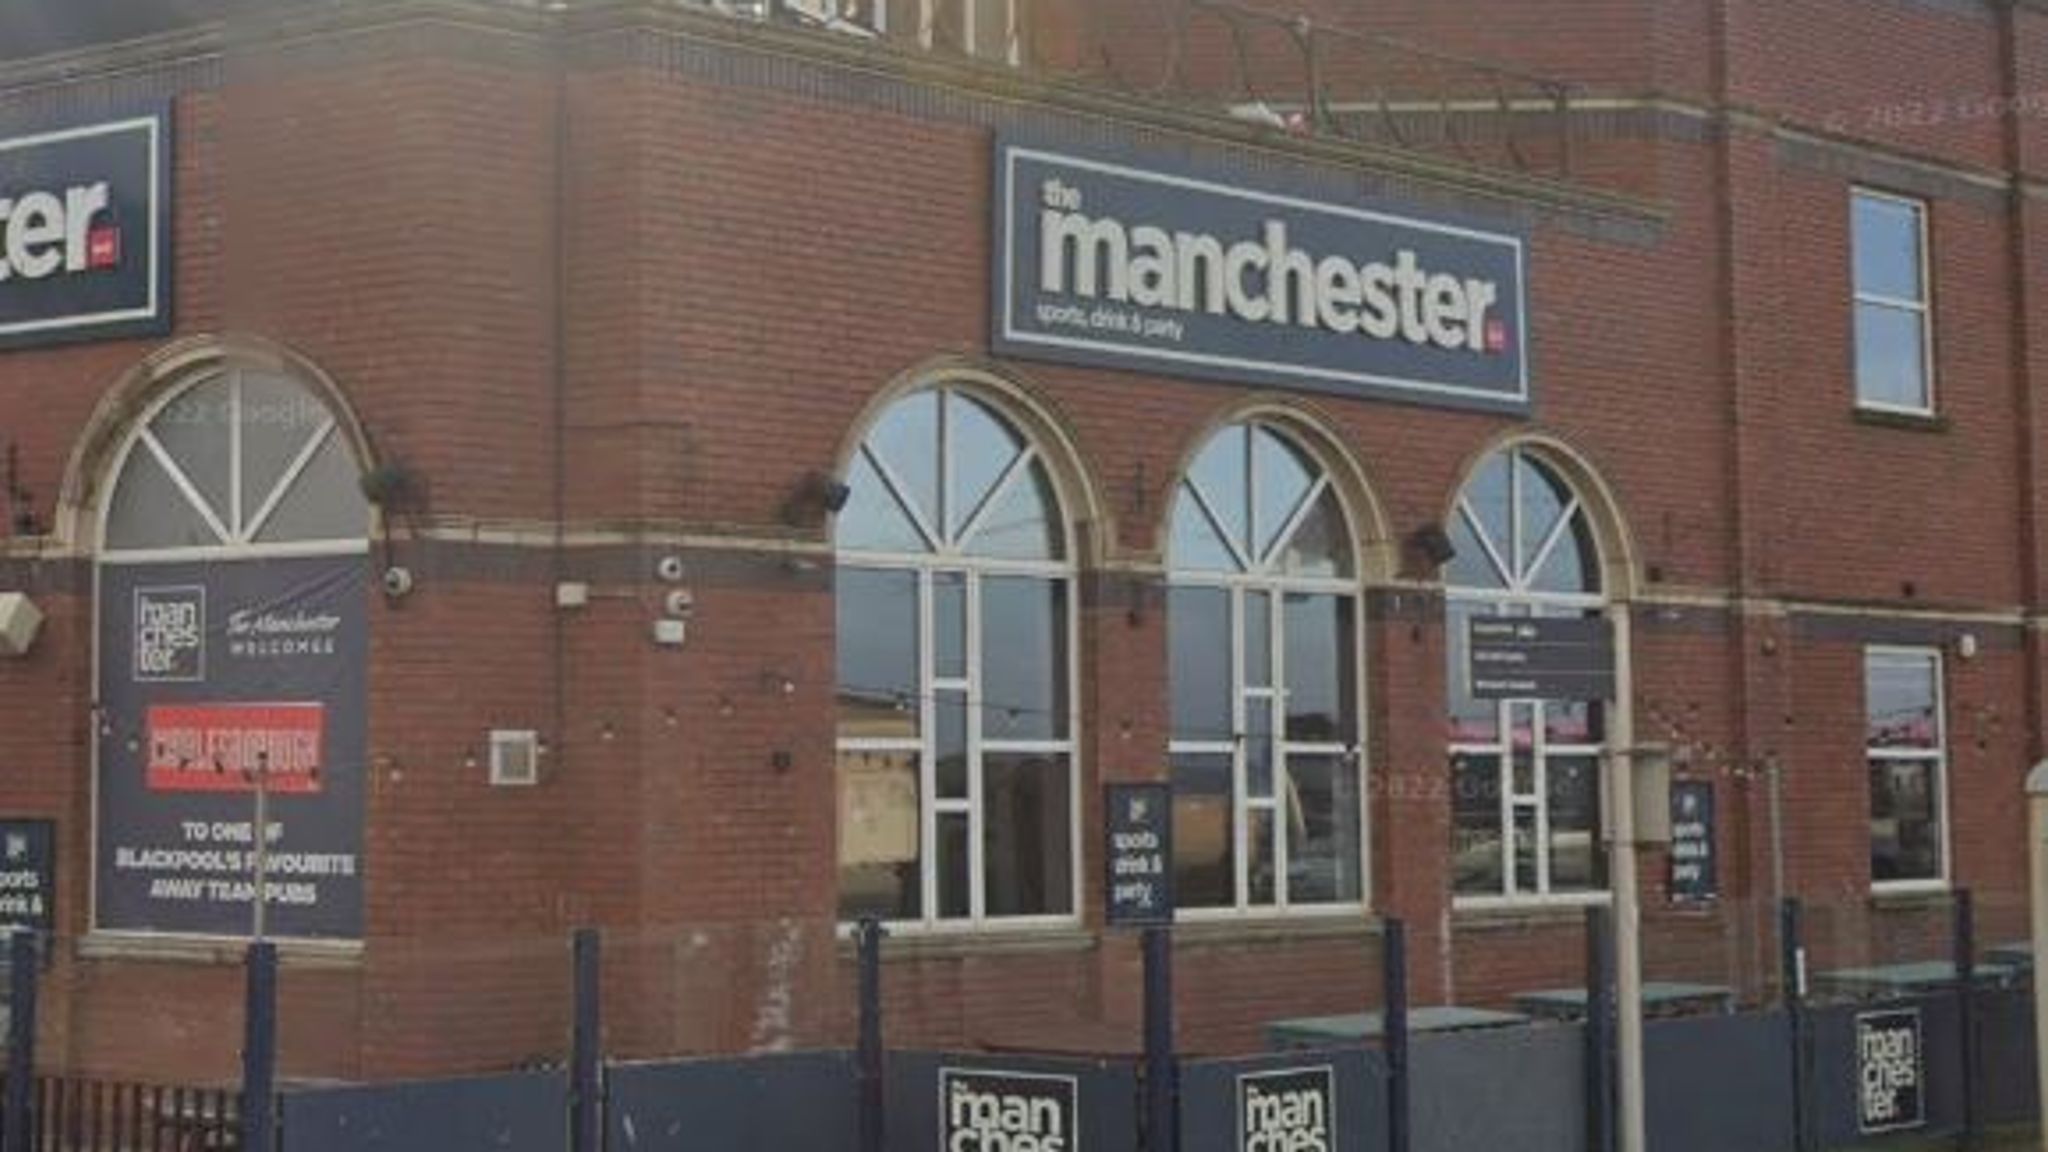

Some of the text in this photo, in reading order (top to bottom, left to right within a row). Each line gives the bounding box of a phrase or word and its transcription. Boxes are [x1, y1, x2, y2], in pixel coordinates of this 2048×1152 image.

[1044, 178, 1082, 209] the
[1040, 208, 1496, 351] manchester
[1143, 317, 1185, 342] party
[181, 821, 209, 841] TO
[211, 821, 253, 842] ONE
[115, 846, 242, 871] BLACKPOOL'S
[149, 878, 204, 901] AWAY
[264, 882, 317, 904] PUBS
[951, 1091, 1062, 1138] man
[1246, 1090, 1323, 1132] man
